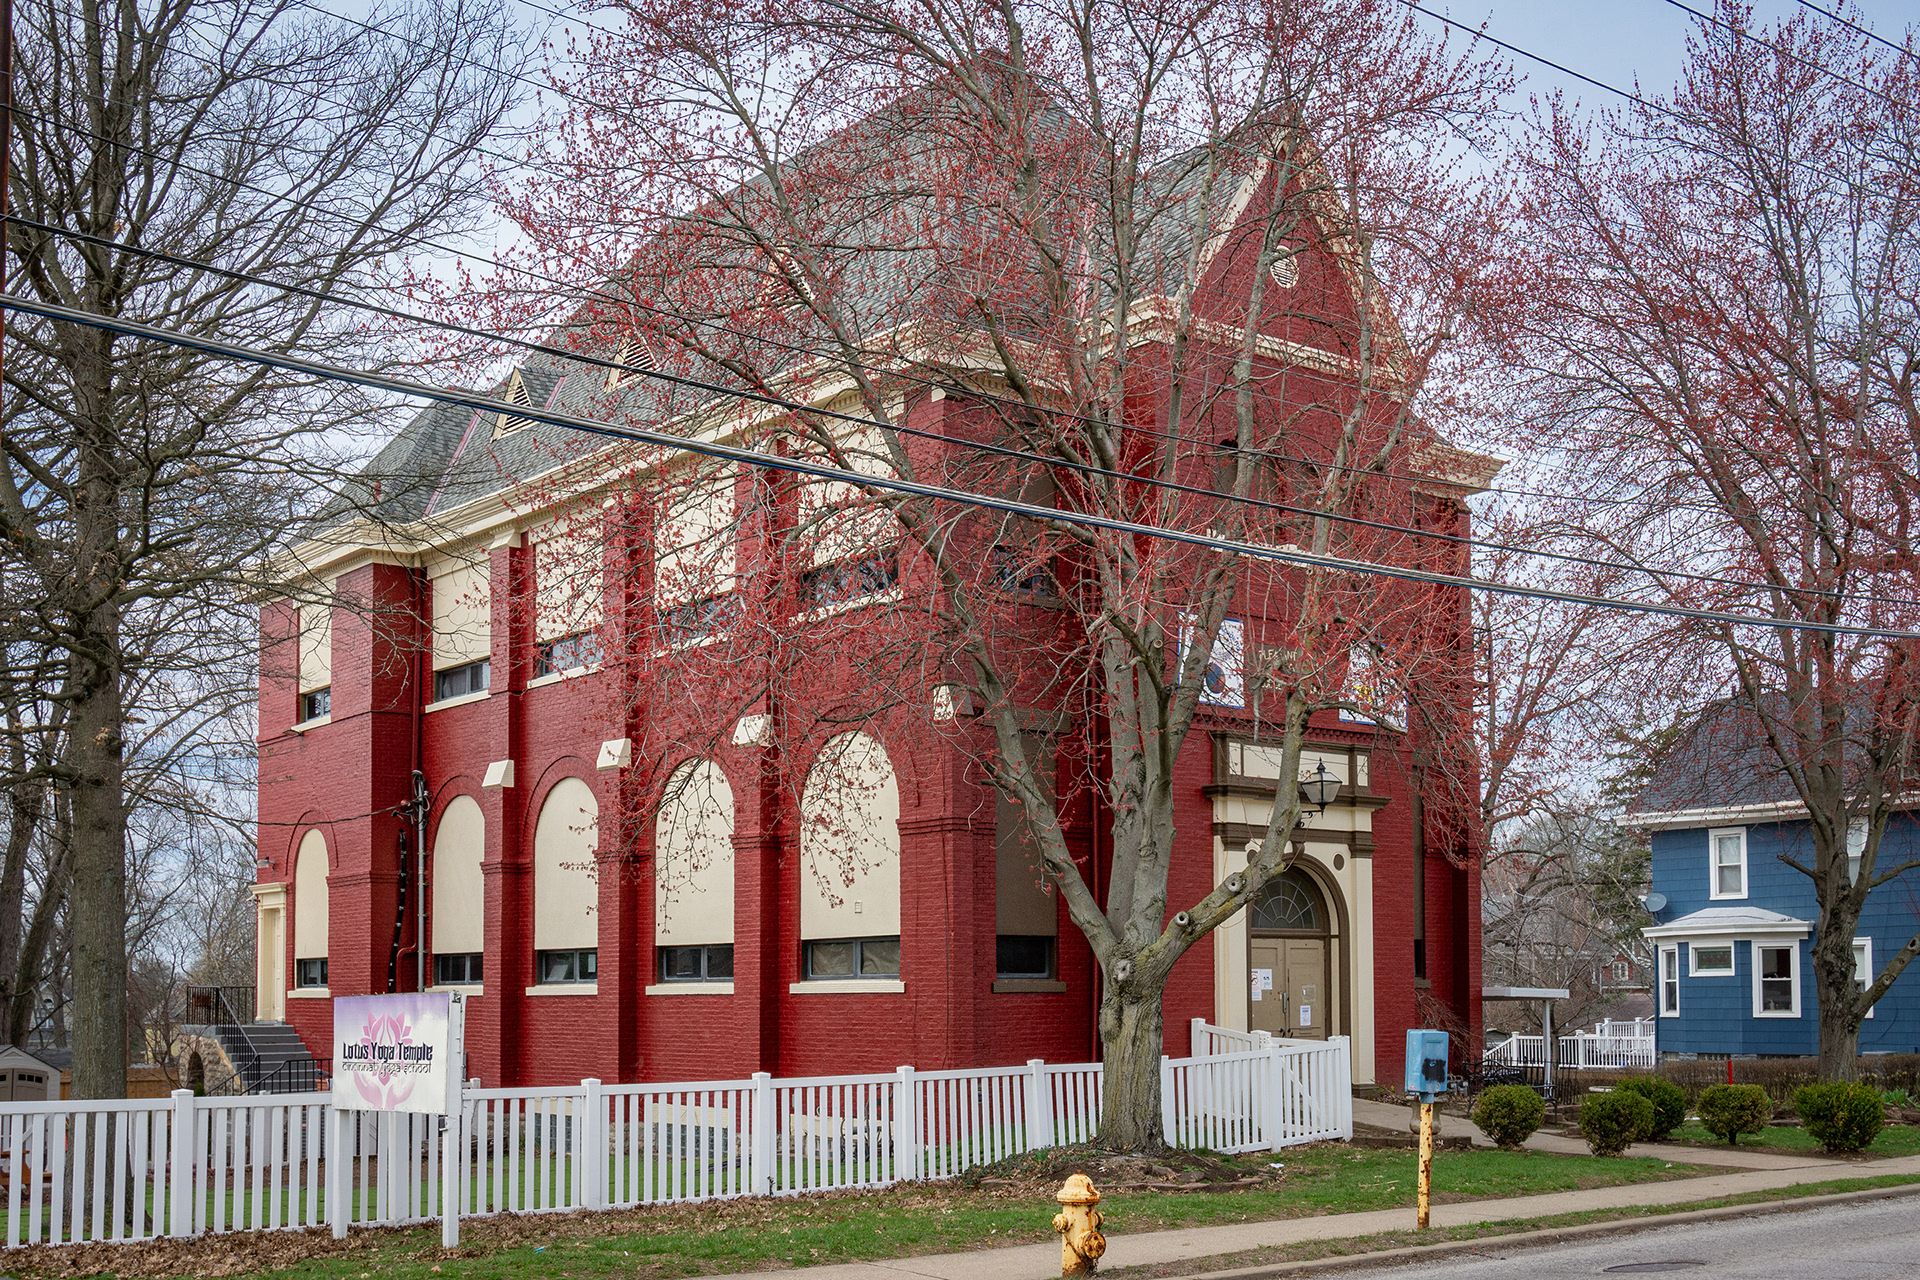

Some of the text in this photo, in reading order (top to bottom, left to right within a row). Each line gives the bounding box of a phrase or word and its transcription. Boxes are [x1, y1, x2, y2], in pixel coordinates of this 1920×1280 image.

[343, 1042, 433, 1063] Lotus Yoga Temple
